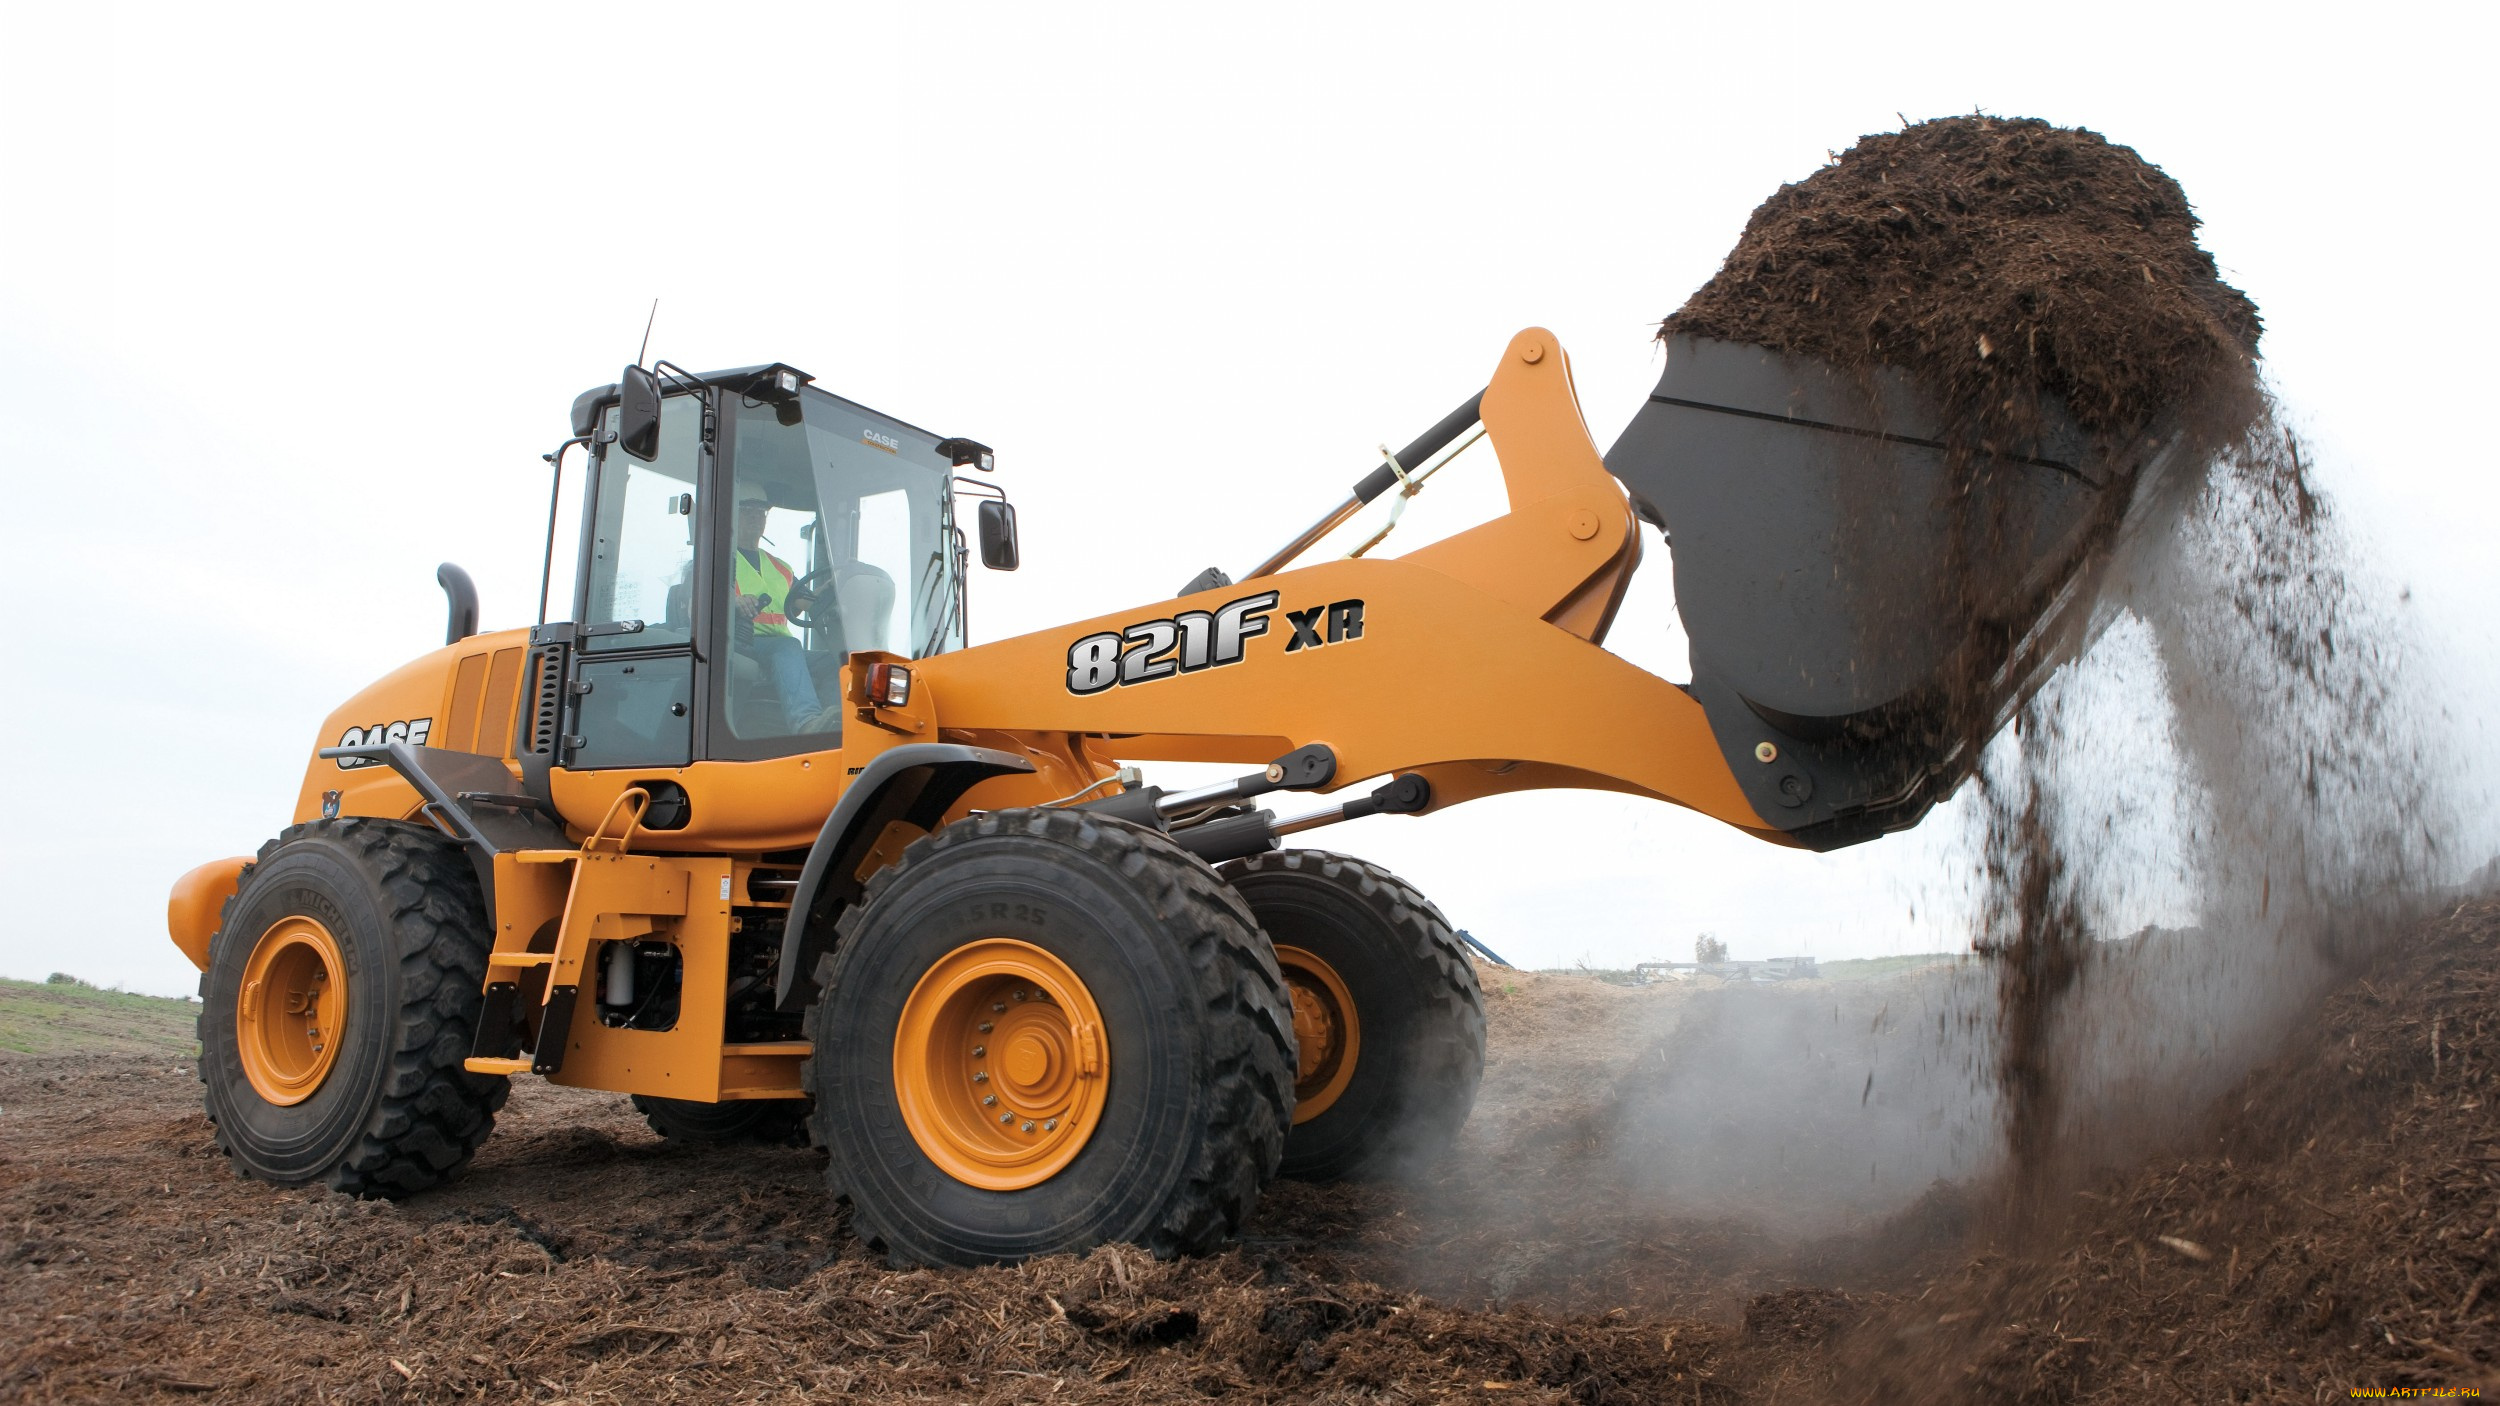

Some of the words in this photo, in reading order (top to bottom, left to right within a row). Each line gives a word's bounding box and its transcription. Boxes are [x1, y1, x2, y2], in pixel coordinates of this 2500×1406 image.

[863, 429, 899, 449] CASE
[1066, 590, 1280, 696] 821F
[1285, 599, 1365, 653] XR
[301, 889, 358, 973] MICHELIN
[990, 902, 1009, 920] R
[1015, 903, 1047, 926] 25
